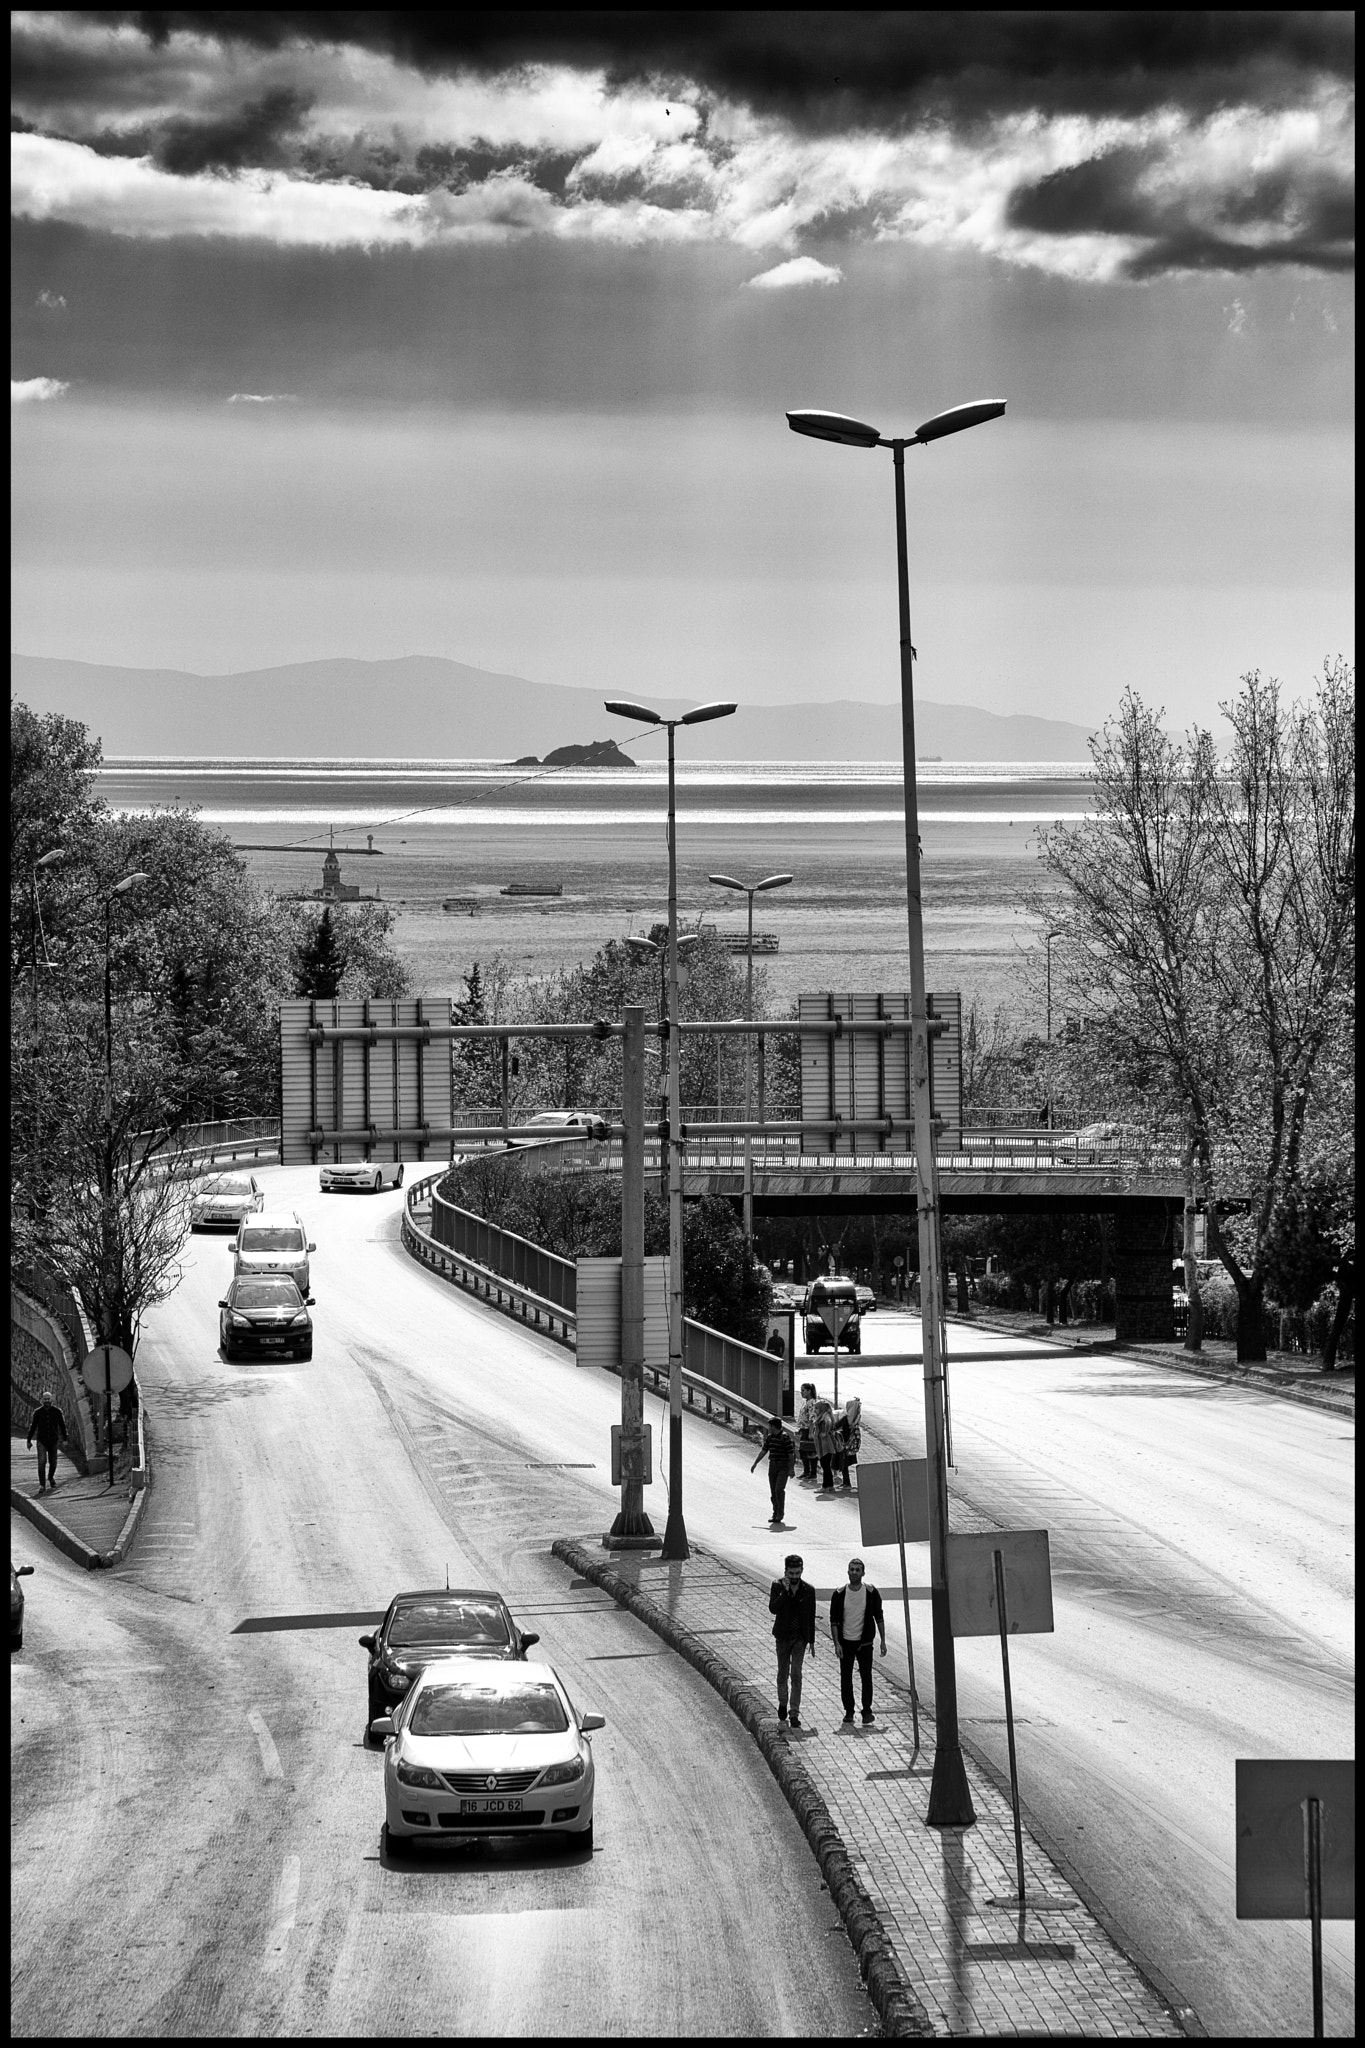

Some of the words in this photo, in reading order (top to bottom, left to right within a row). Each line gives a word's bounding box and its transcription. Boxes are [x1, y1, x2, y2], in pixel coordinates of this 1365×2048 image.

[467, 1801, 477, 1811] 16
[483, 1801, 504, 1811] JCD
[508, 1800, 520, 1811] 62
